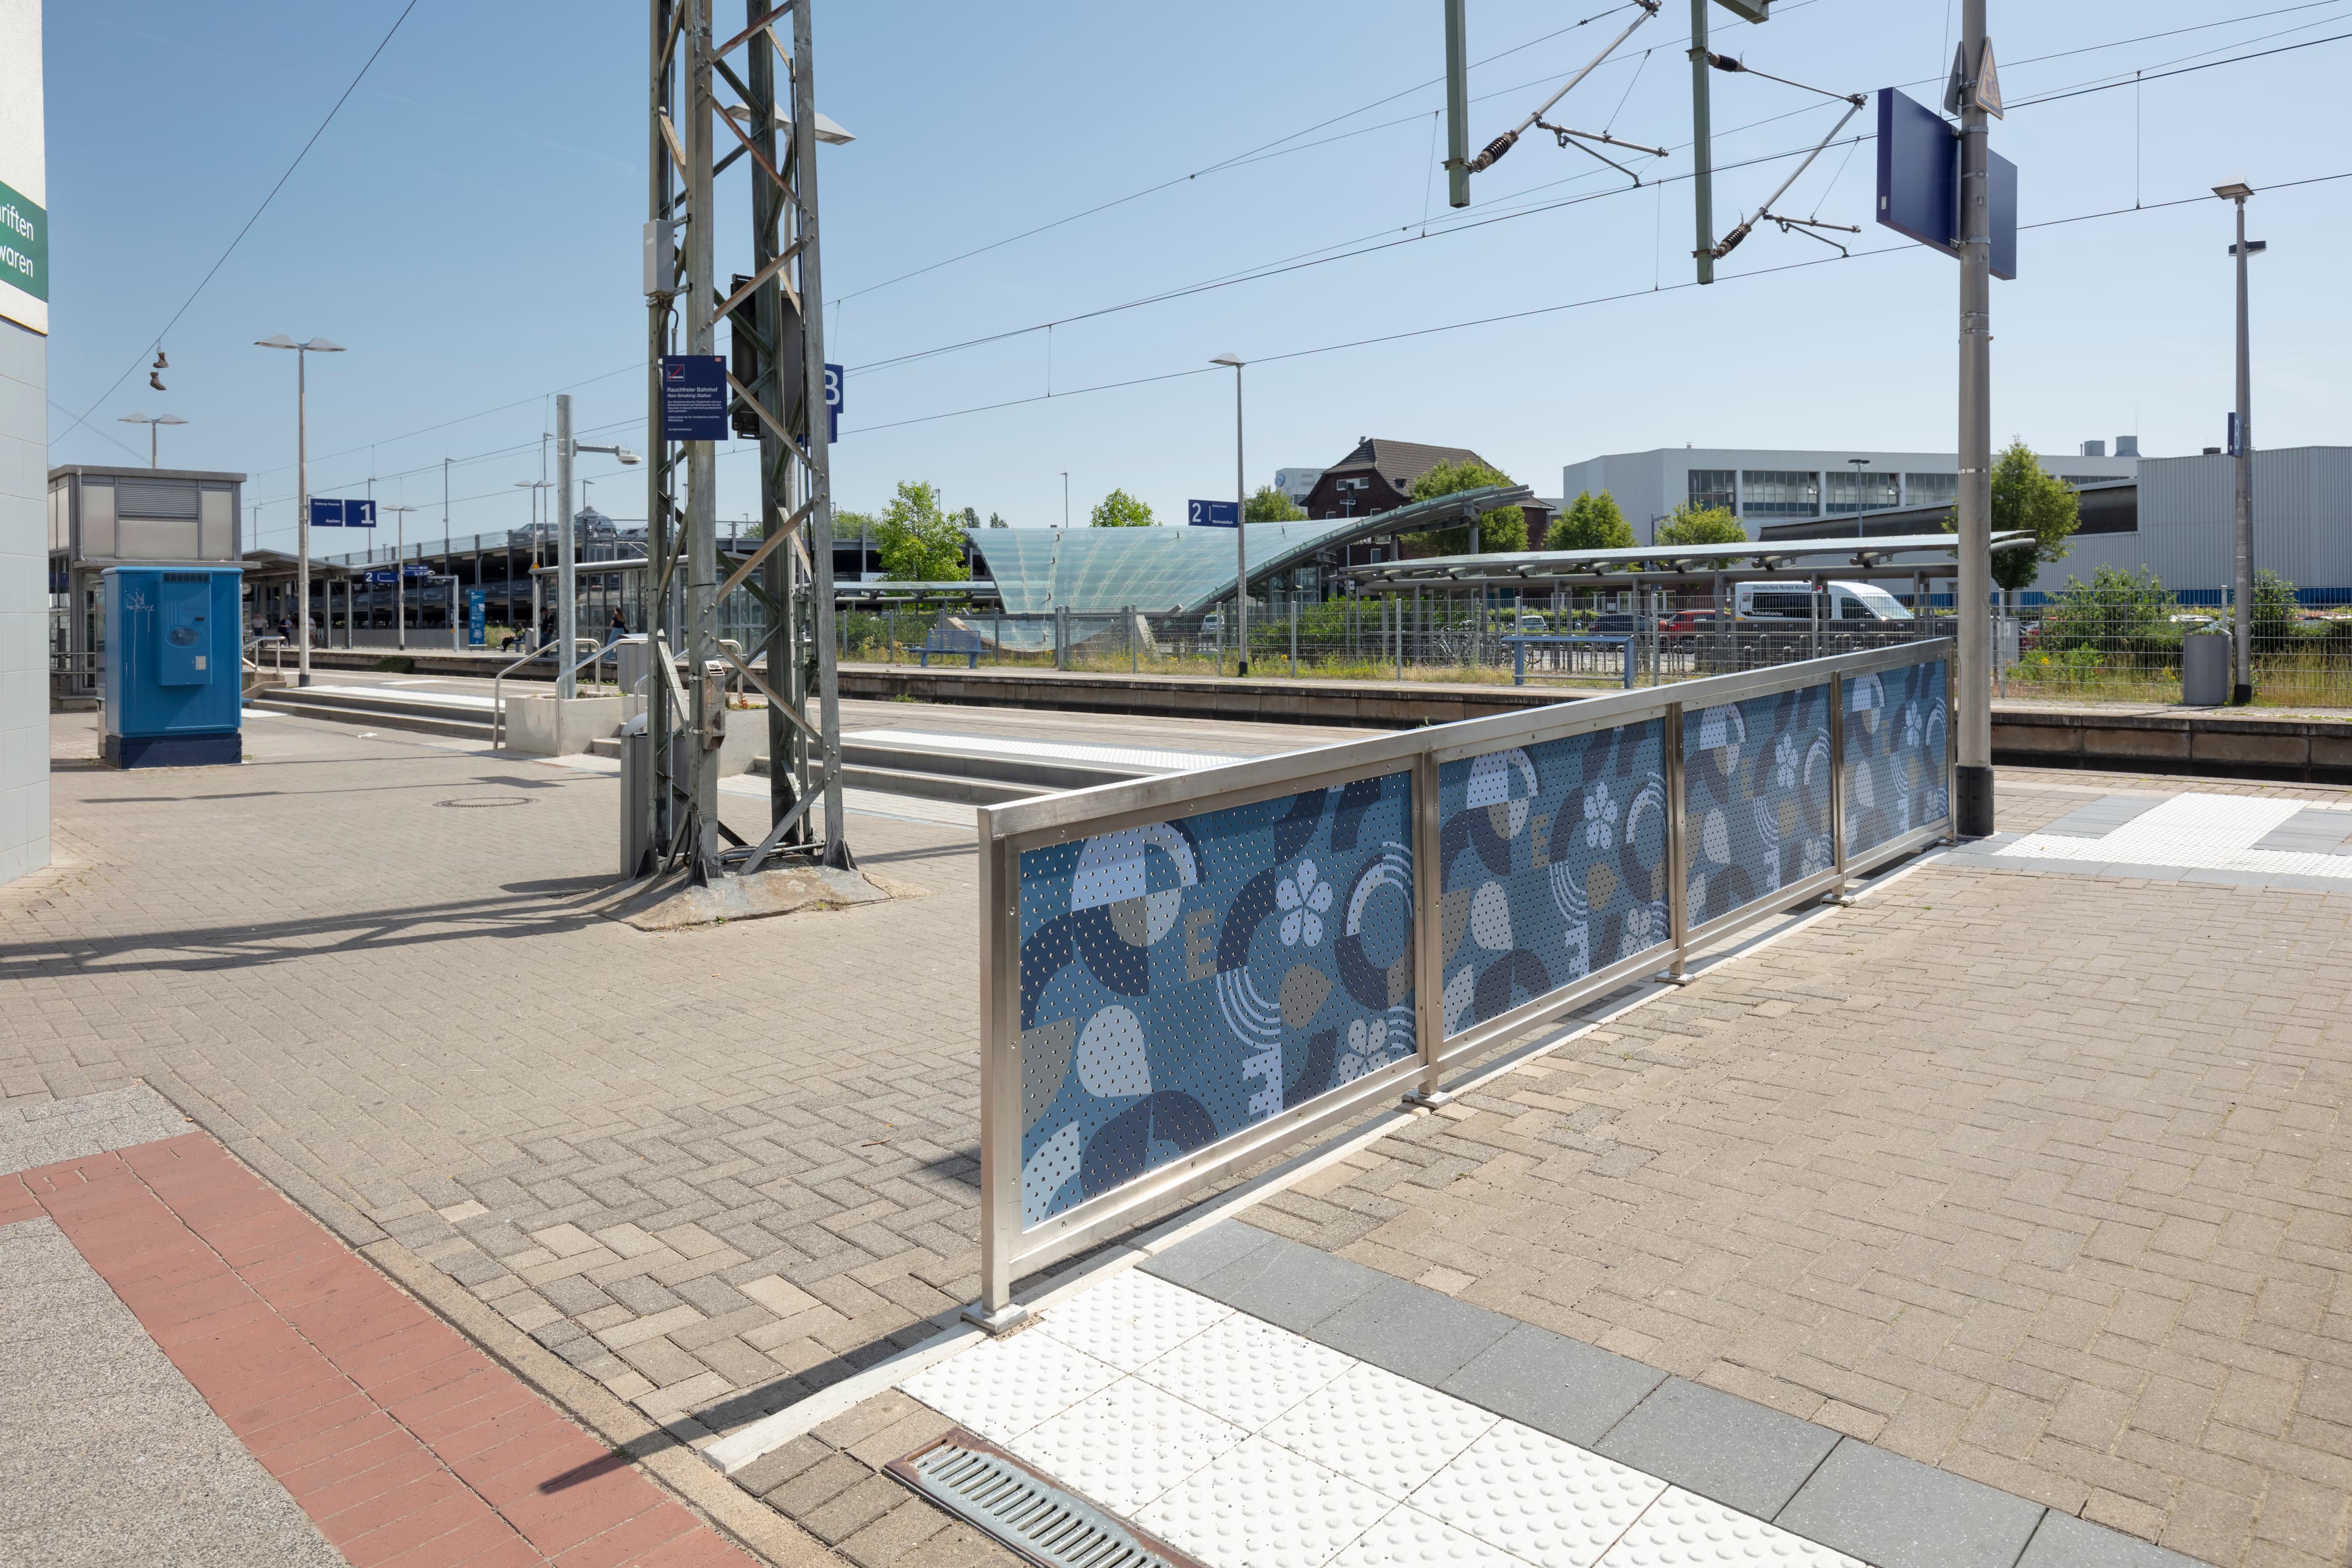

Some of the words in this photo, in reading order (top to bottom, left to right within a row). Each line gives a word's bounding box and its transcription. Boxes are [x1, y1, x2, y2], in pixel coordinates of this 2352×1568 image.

[0, 203, 34, 241] riften
[360, 503, 374, 524] 1
[1192, 502, 1202, 522] 2
[366, 572, 373, 582] 2
